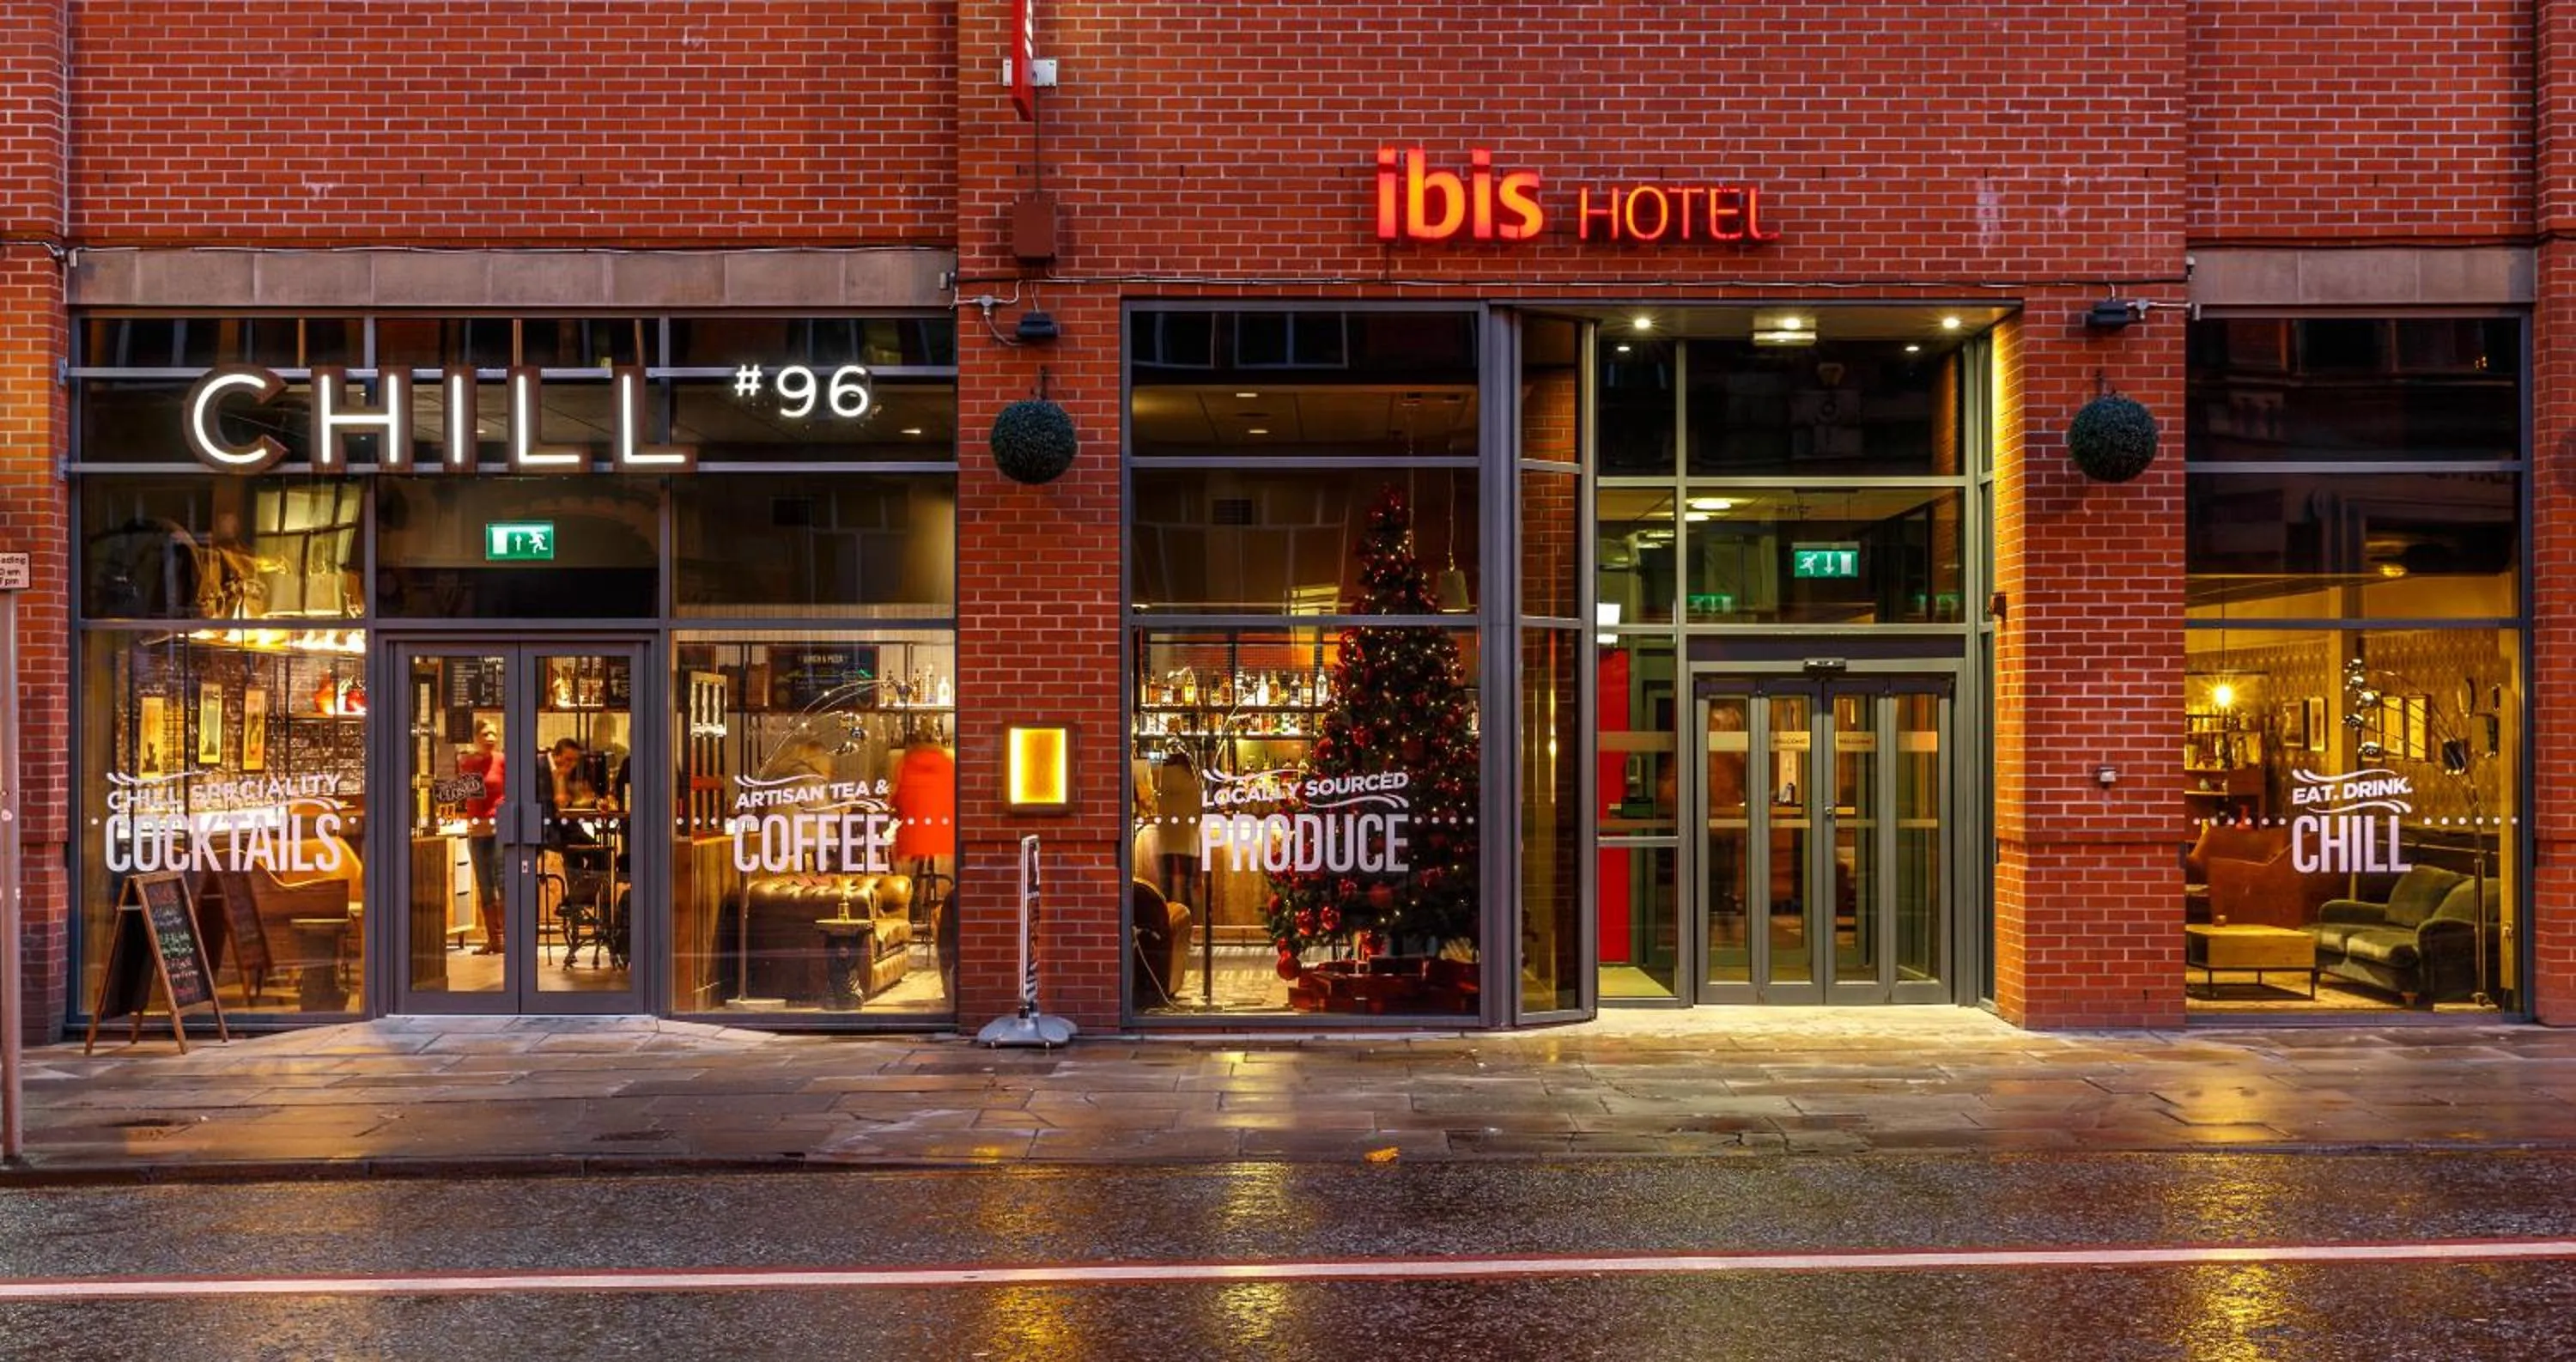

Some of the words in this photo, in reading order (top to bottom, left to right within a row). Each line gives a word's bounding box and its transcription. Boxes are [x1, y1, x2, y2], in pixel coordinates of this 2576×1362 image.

[1376, 147, 1545, 240] ibis
[1577, 185, 1782, 242] HOTEL
[185, 366, 696, 472] CHILL
[734, 364, 869, 418] #96
[107, 787, 185, 810] CHILL
[190, 774, 342, 802] SPECIALITY
[735, 784, 825, 809] ARTISAN
[829, 781, 871, 800] TEA
[874, 779, 890, 794] &
[1202, 781, 1302, 807] LOCALLY
[1304, 773, 1410, 798] SOURCED
[2292, 784, 2340, 806] EAT.
[2342, 776, 2414, 800] DRINK.
[105, 813, 342, 873] COCKTAILS
[733, 813, 890, 873] COFFEE
[1201, 812, 1410, 873] PRODUCE
[2292, 815, 2413, 874] CHILL
